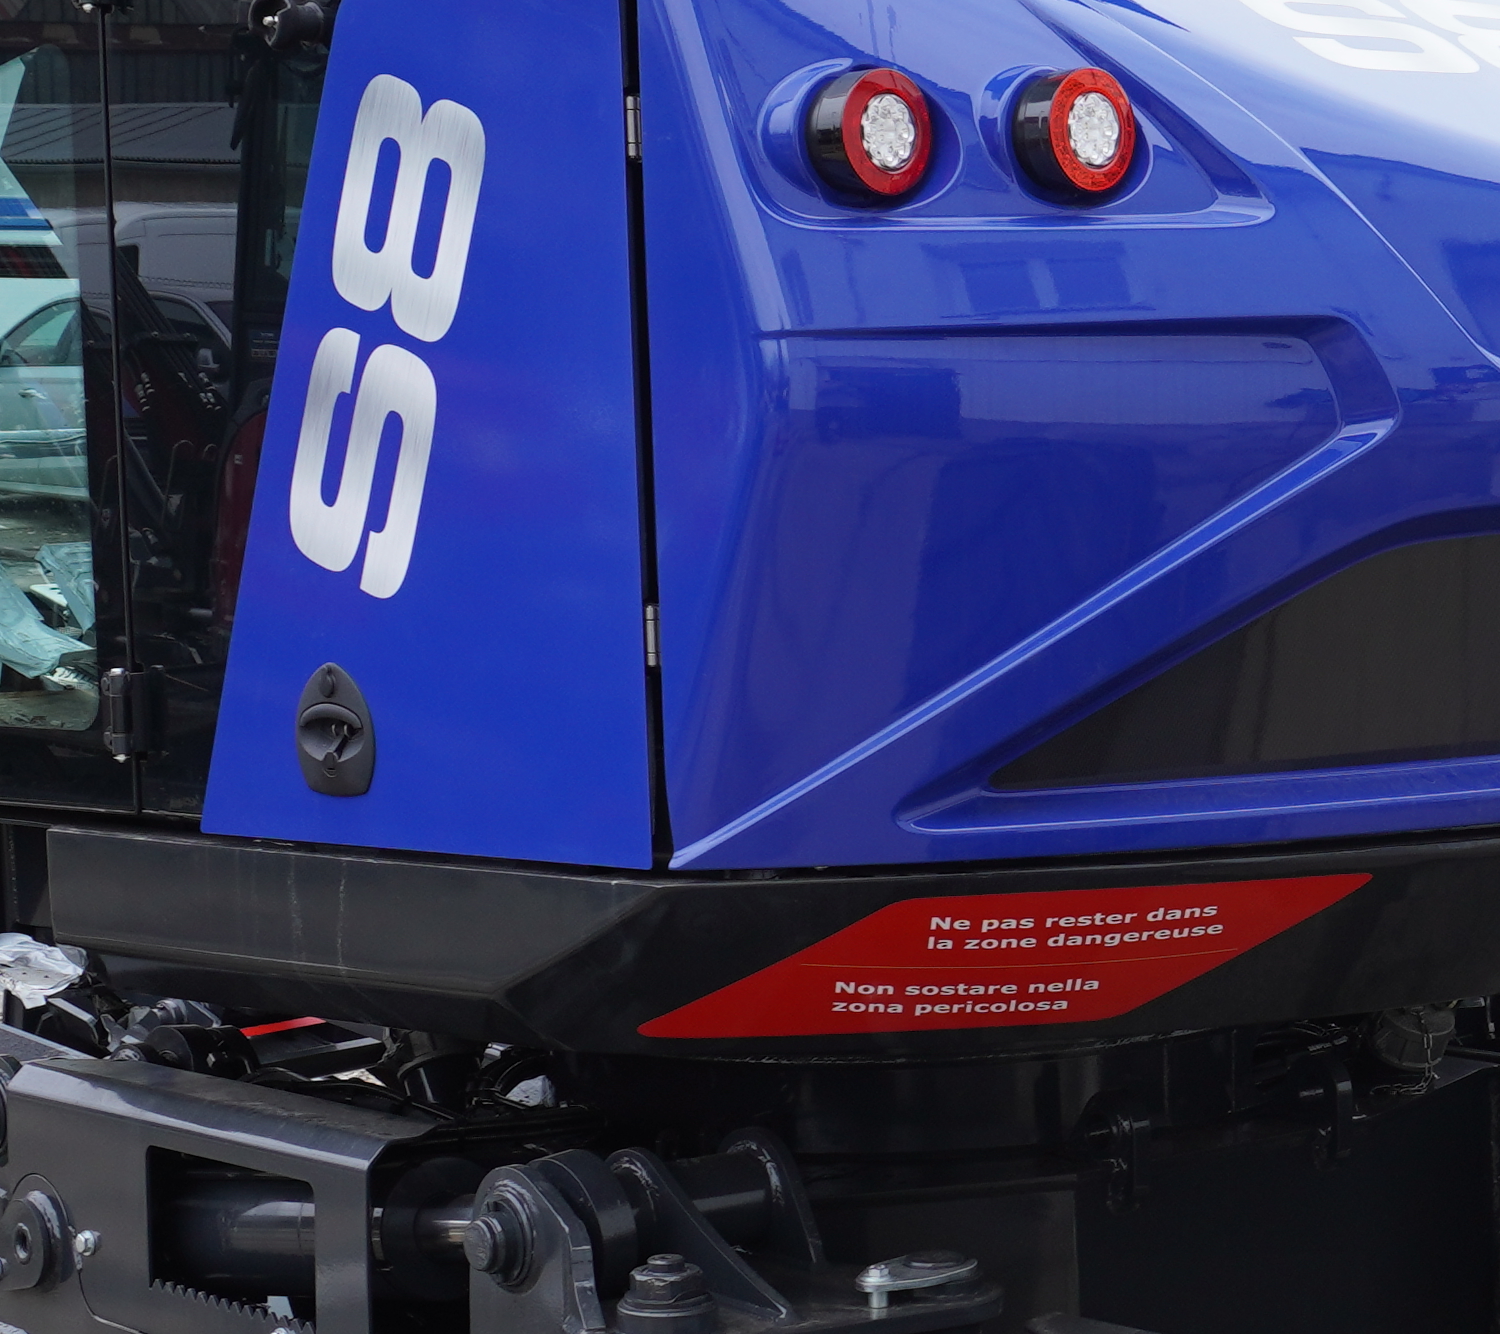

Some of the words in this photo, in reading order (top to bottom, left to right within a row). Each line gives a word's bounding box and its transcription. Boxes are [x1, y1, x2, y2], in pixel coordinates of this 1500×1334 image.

[288, 72, 487, 600] S8
[929, 916, 971, 931] Ne
[981, 916, 1035, 933] pas
[1045, 910, 1138, 929] rester
[1146, 904, 1219, 923] dans
[927, 935, 953, 950] la
[963, 934, 1038, 950] zone
[1046, 922, 1225, 948] dangereuse
[834, 980, 895, 997] Non
[905, 979, 1019, 996] sostare
[1027, 977, 1101, 994] nella
[831, 1000, 904, 1015] zona
[914, 998, 1069, 1017] pericolosa
